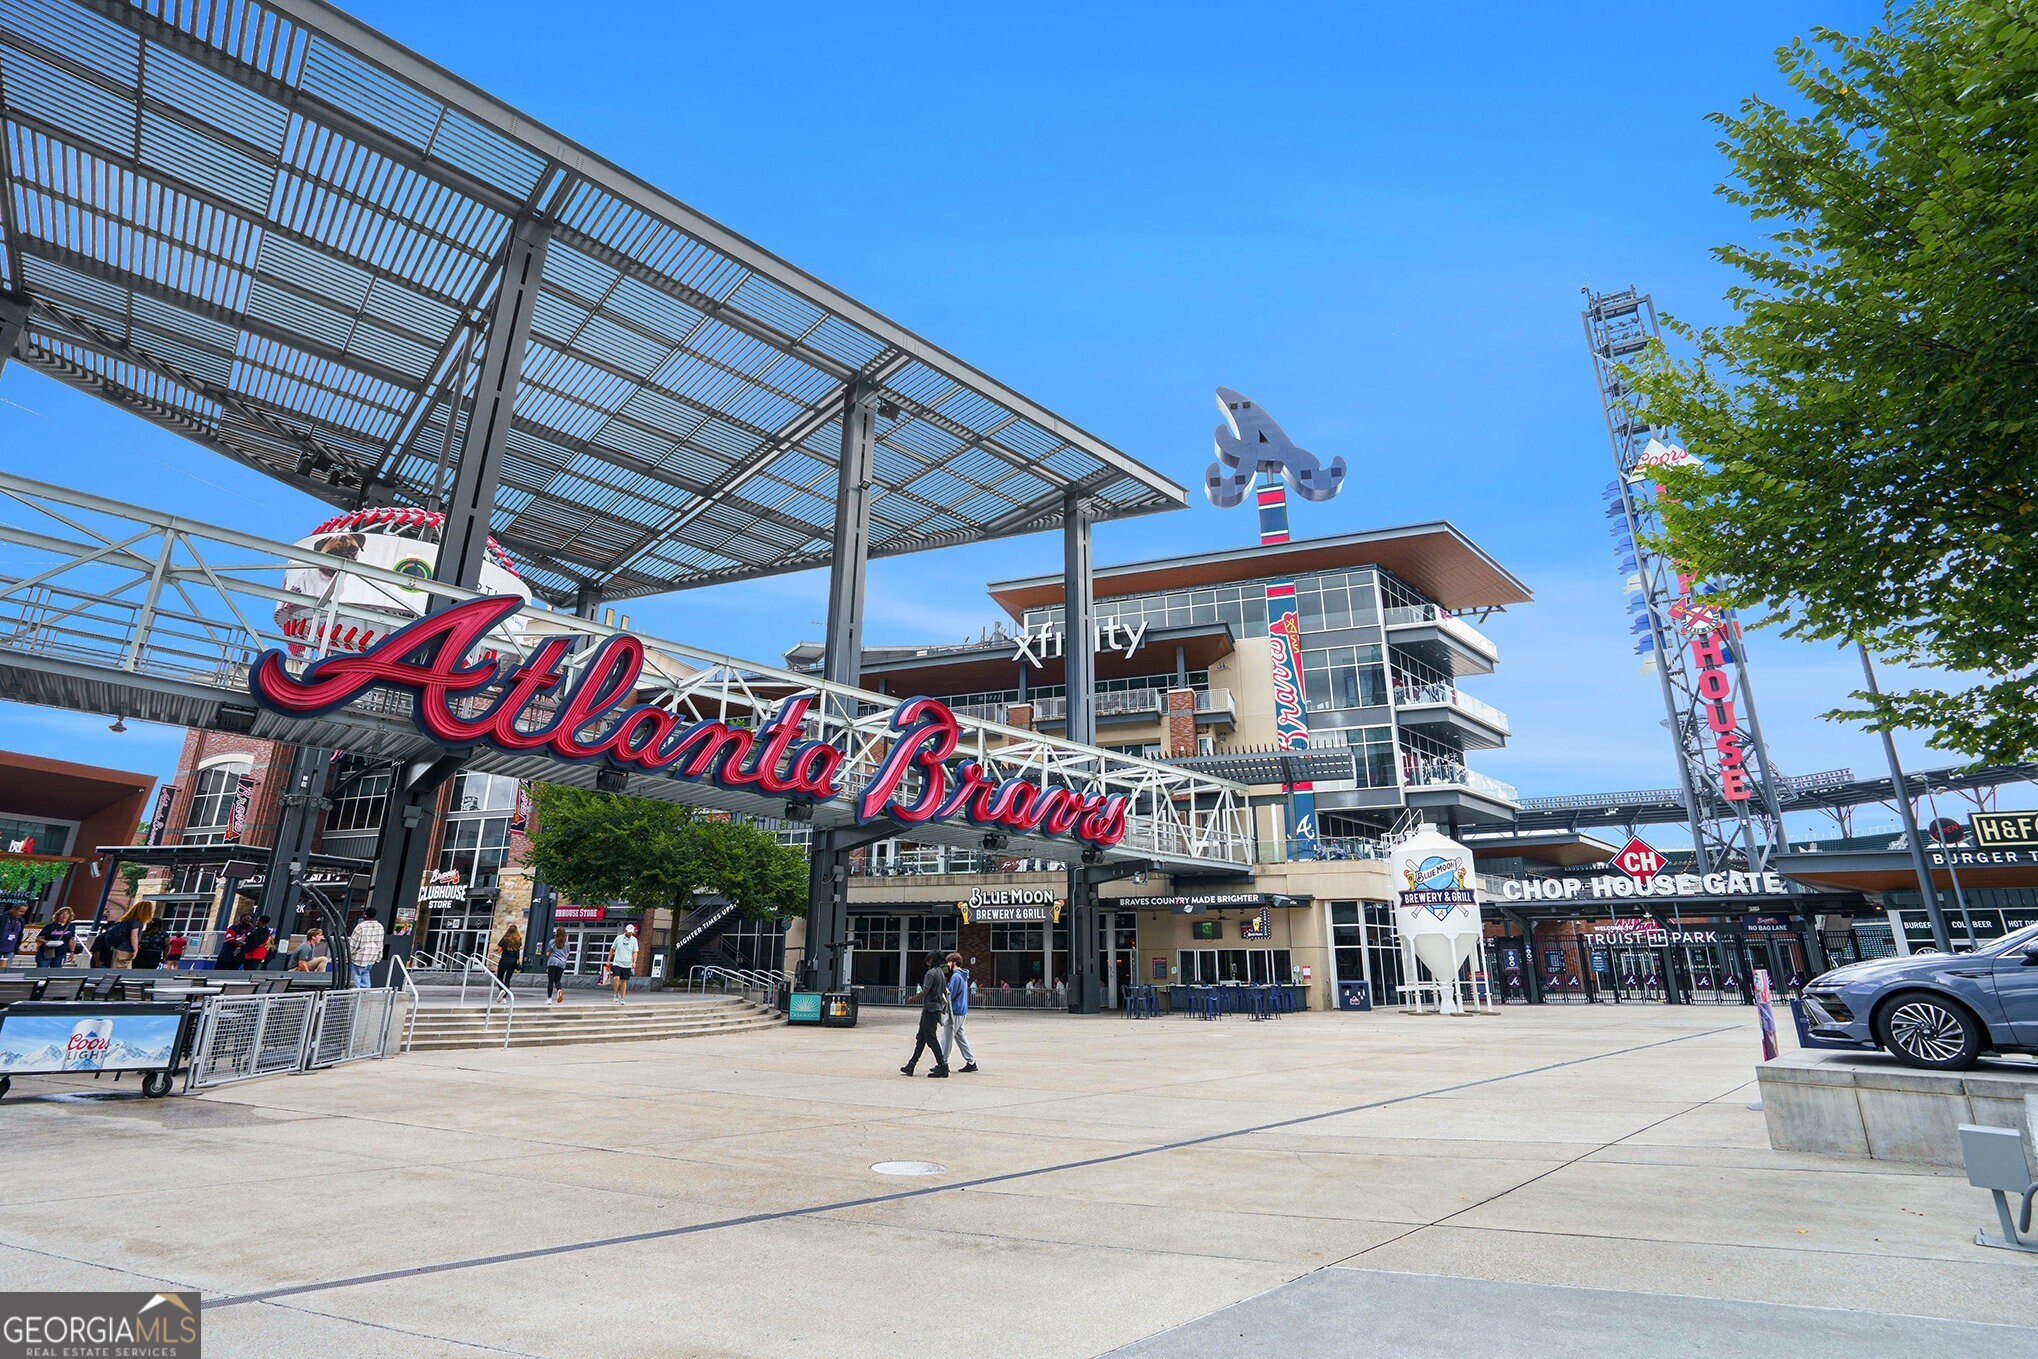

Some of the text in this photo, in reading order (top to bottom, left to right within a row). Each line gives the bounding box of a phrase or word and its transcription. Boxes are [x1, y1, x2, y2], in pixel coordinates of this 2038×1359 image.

[1011, 616, 1149, 668] xfiity
[249, 594, 1127, 850] Atlanta Braves
[1690, 639, 1752, 801] HOUSE
[1623, 851, 1657, 873] CH
[1416, 862, 1456, 882] BLUE MOON
[418, 885, 467, 902] CLUBHOUSE
[1502, 871, 1784, 900] CHOP HOUSE GATE
[428, 900, 452, 909] STORE
[969, 887, 1054, 908] BLUE MOON
[1119, 894, 1259, 906] BRAVES COUNTRY MADE BRIGHTER
[1404, 891, 1472, 904] BREWERY & GRILL
[580, 908, 598, 918] STORE
[976, 908, 1046, 920] BREWERY & GRILL
[675, 926, 703, 950] RIGHTER
[702, 911, 721, 930] TIMES
[1903, 921, 1932, 929] BURGER
[1951, 920, 1992, 929] COL BEER
[1584, 931, 1717, 945] TRUIST PARK
[67, 1033, 110, 1051] Coors
[67, 1051, 106, 1060] LIGHT
